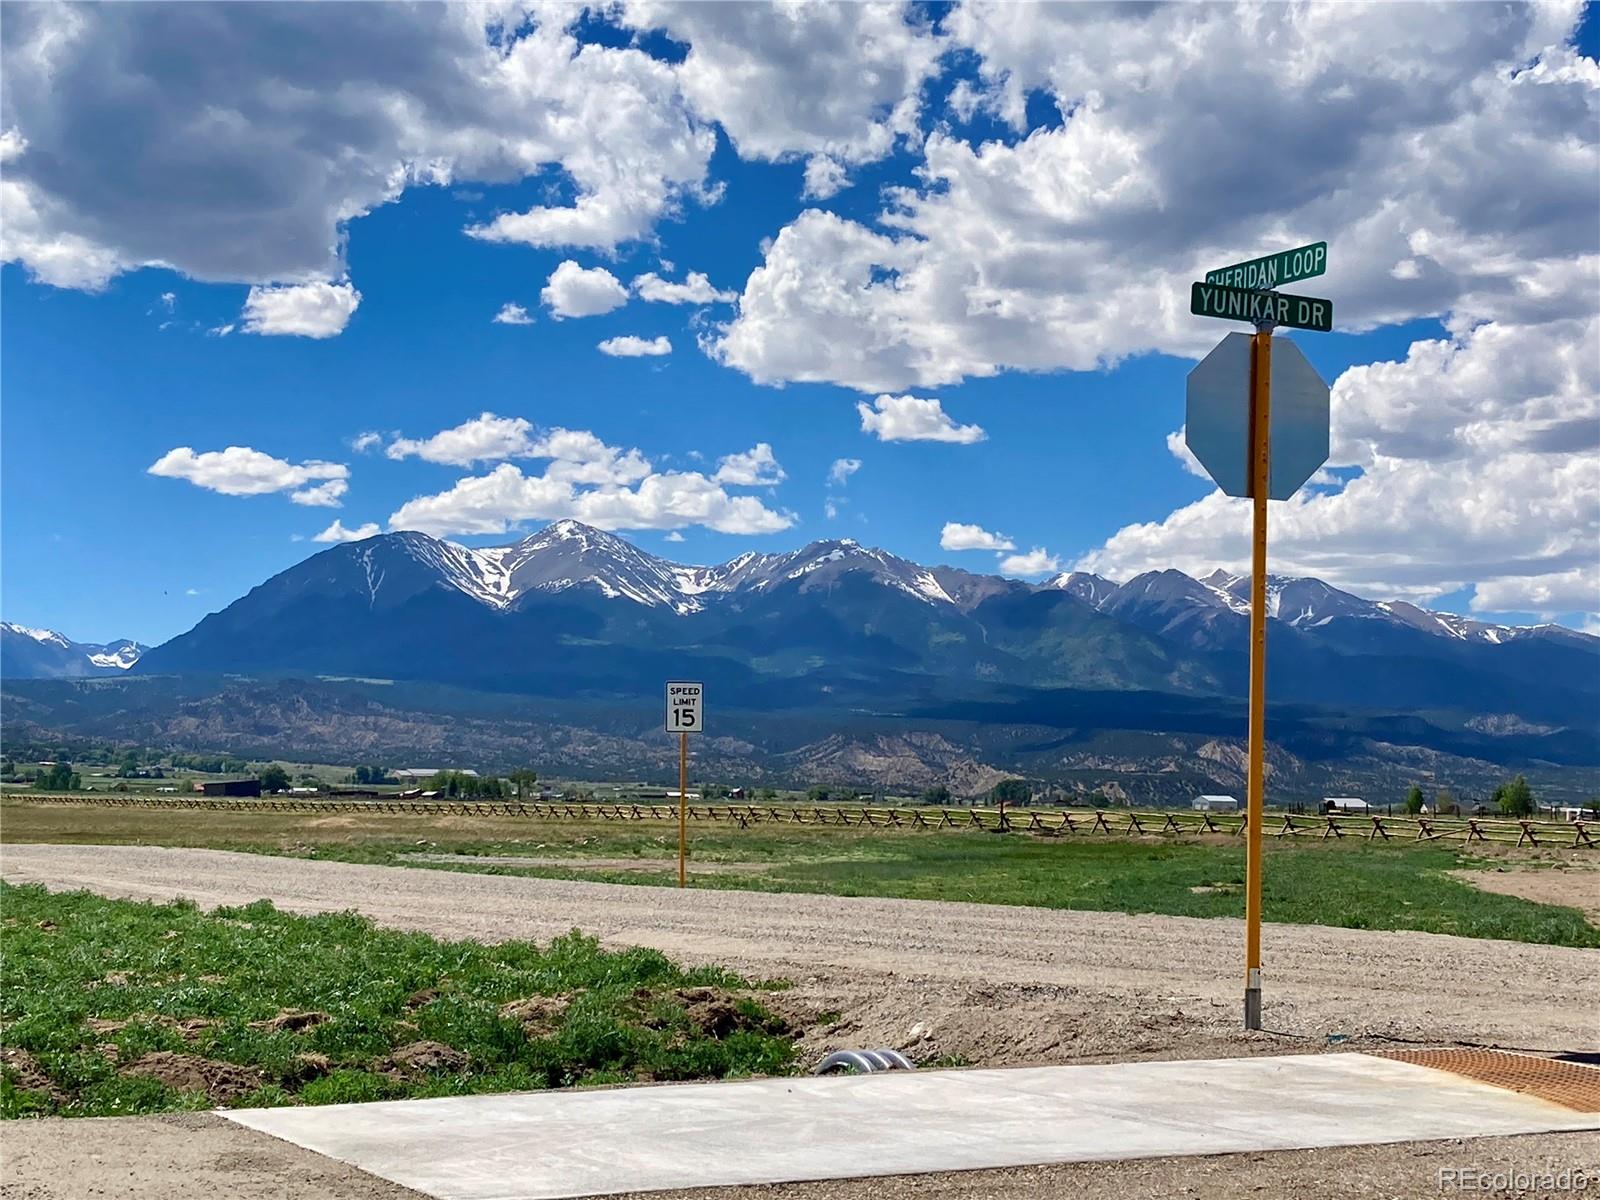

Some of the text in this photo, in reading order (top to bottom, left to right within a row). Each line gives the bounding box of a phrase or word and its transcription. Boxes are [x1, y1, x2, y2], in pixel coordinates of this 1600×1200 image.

[1284, 247, 1324, 279] LOOP
[1201, 287, 1324, 327] YUNIKAR DR
[670, 687, 700, 695] SPEED
[673, 698, 696, 706] LIMIT
[673, 708, 695, 727] 15
